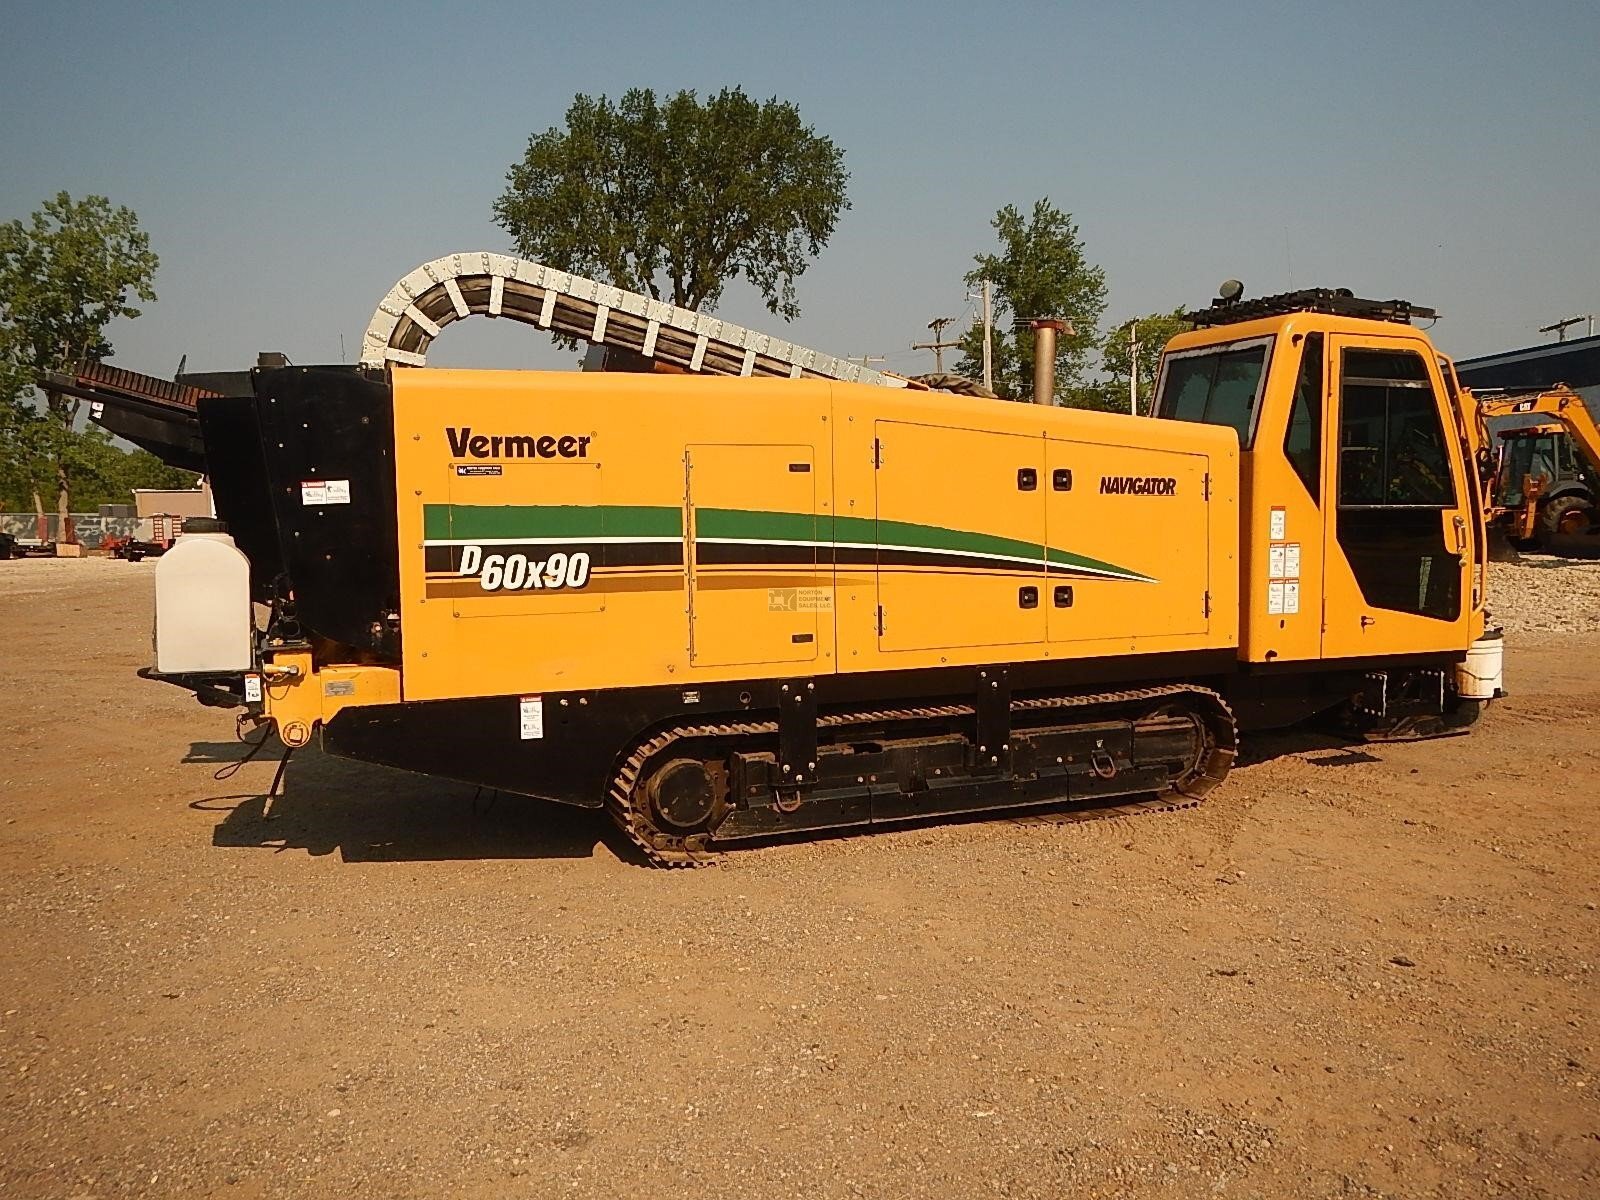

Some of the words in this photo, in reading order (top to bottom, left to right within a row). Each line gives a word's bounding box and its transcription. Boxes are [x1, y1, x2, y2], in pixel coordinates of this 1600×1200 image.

[445, 427, 591, 458] Vermeer
[1099, 476, 1177, 495] NAVIGATOR
[459, 545, 590, 591] D60x90
